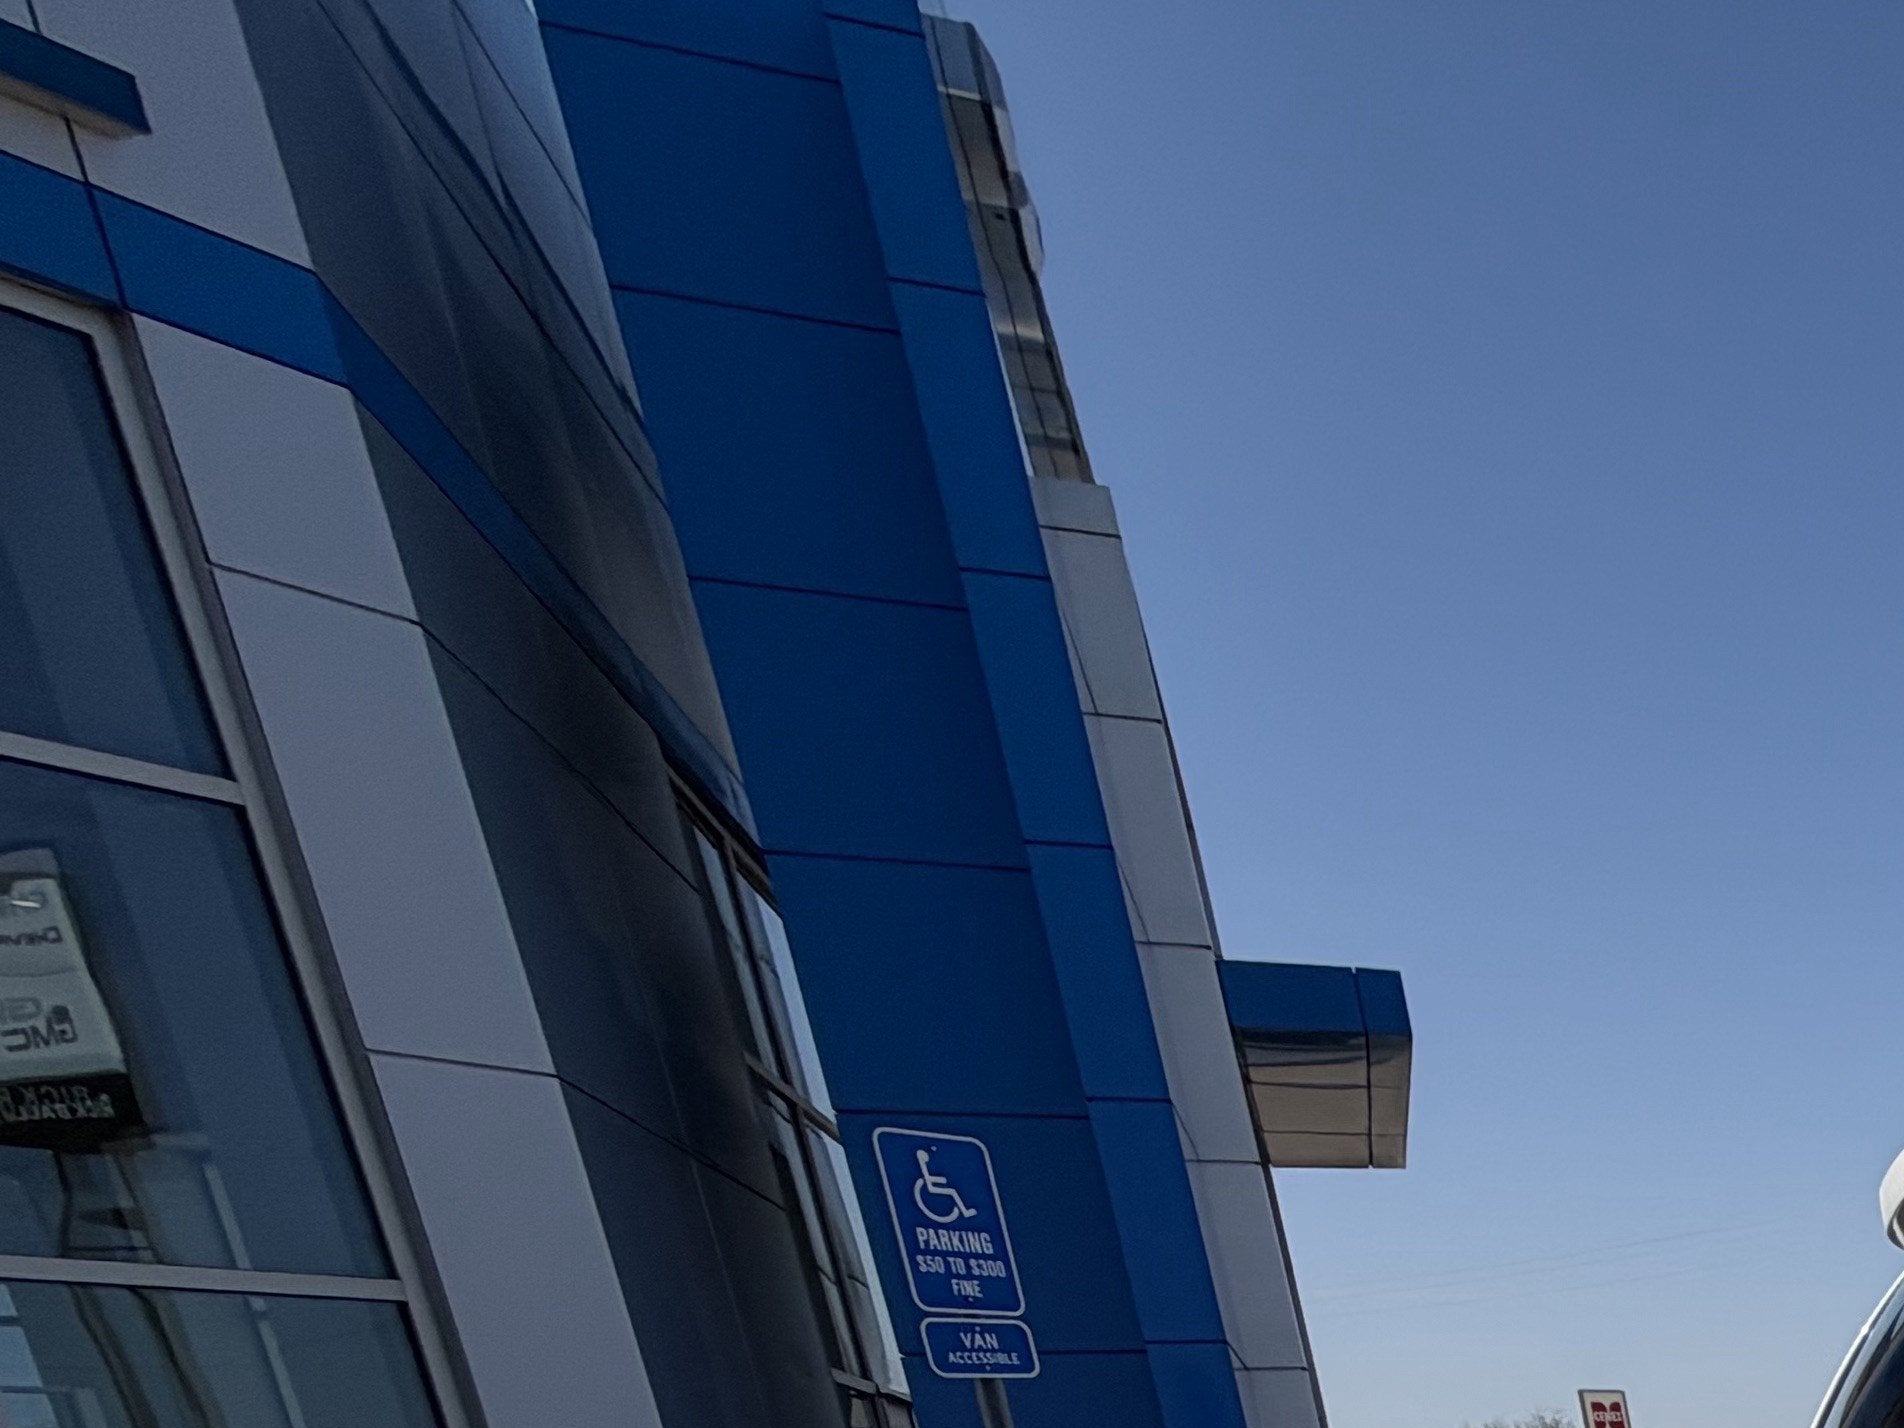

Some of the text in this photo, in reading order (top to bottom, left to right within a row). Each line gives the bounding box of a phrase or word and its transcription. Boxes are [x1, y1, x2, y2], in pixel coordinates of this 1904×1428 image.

[915, 1227, 994, 1254] PARKING
[915, 1255, 1007, 1278] $50 TO $300
[951, 1279, 984, 1299] FINE
[960, 1331, 999, 1350] VAN
[948, 1351, 1021, 1366] ACCESSIBLE
